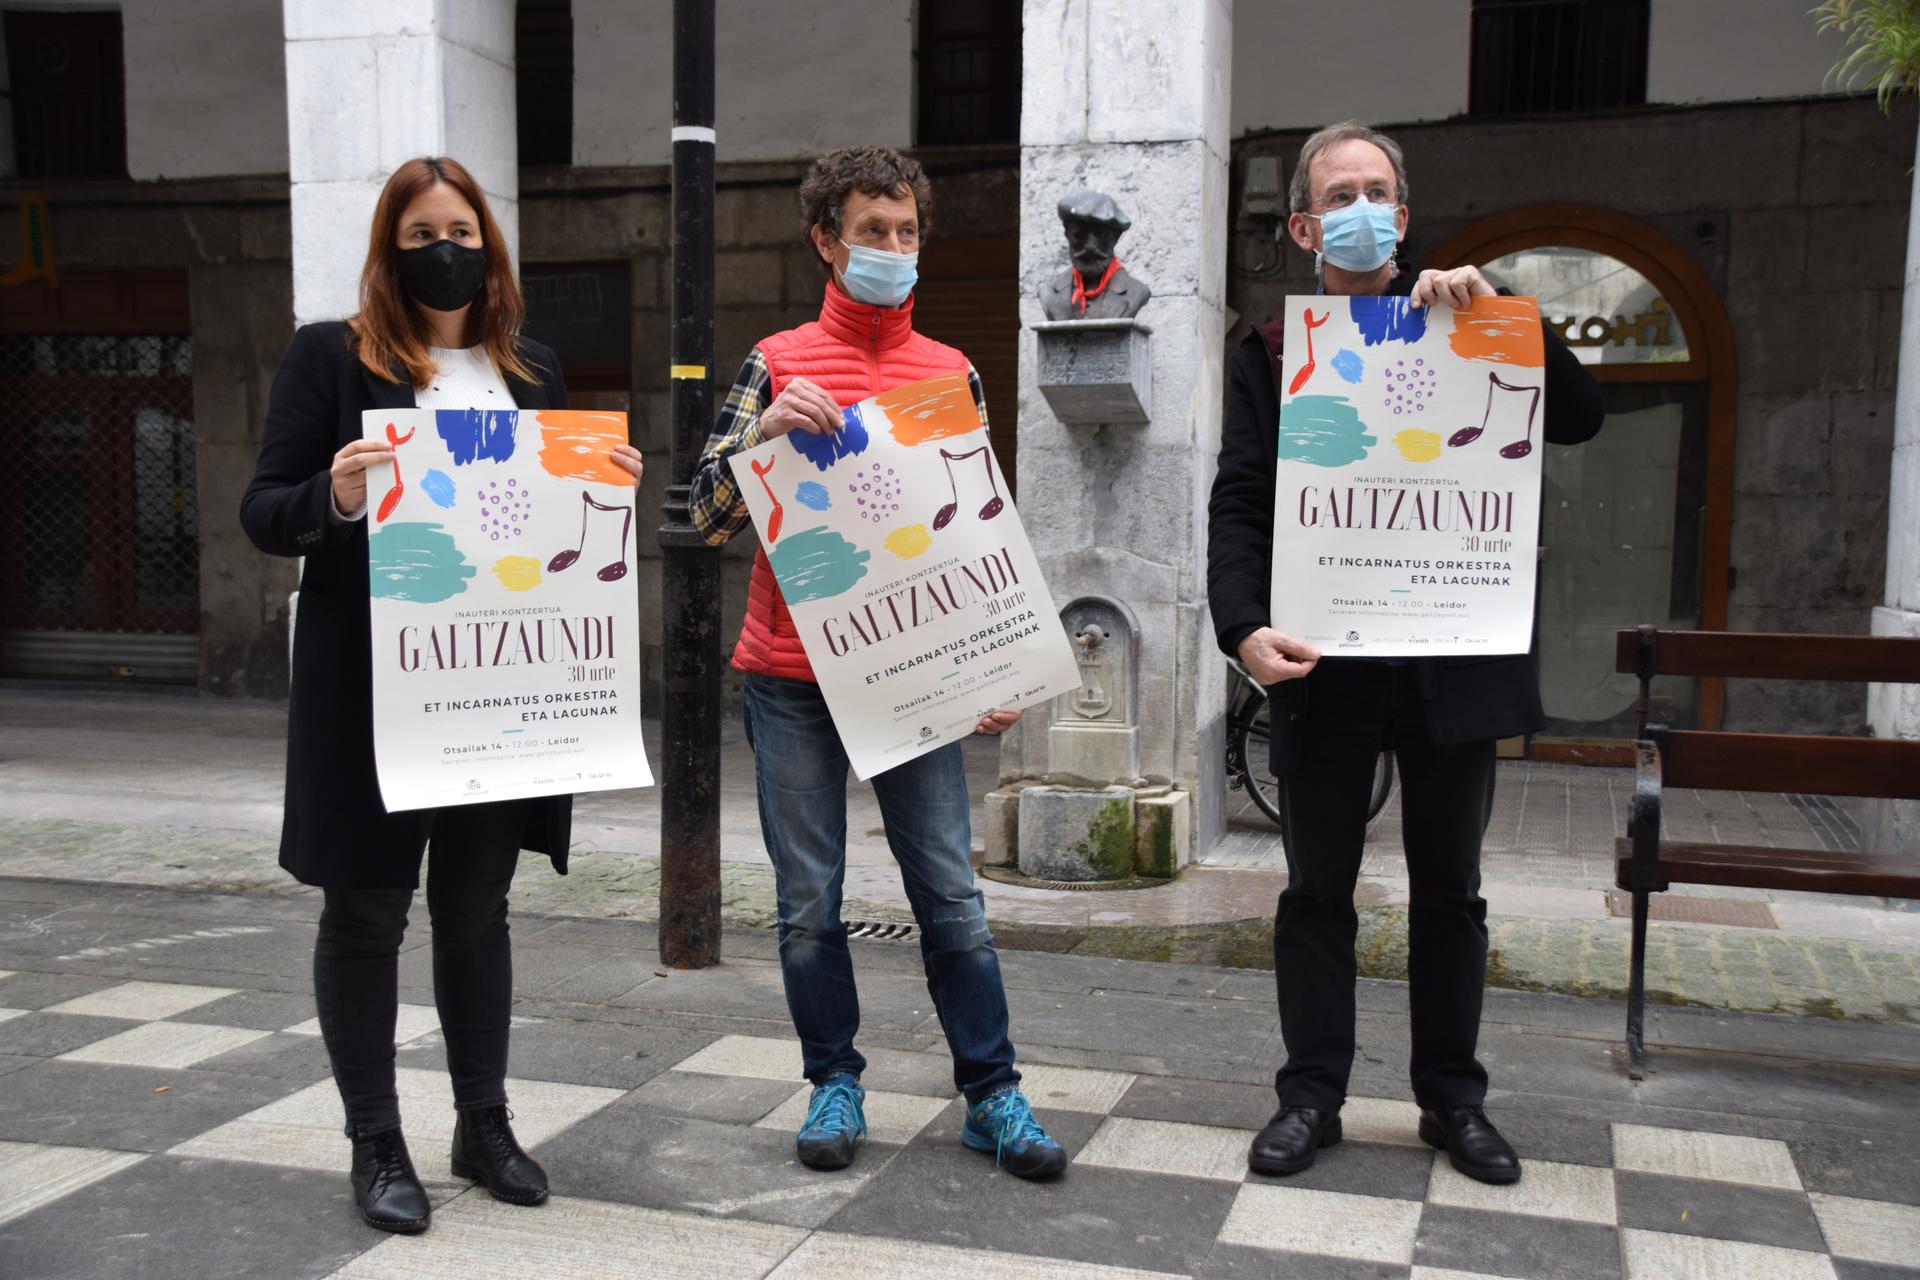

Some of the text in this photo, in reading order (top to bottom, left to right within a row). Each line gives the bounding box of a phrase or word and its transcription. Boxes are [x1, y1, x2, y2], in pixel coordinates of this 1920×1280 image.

[1354, 476, 1460, 486] INAUTERI KONTZERTUA
[1299, 485, 1515, 533] GALTZAUNDI
[1461, 535, 1512, 553] 30 urte
[1318, 556, 1512, 571] ET INCARNATUS ORKESTRA
[864, 557, 960, 598] INAUTERI KONTZERTUA
[1411, 575, 1511, 586] ETA LAGUNAK
[455, 606, 562, 619] INAUTERI KONTZERTUA
[822, 547, 1021, 658] GALTZAUNDI
[982, 589, 1028, 619] 30 urte
[1332, 598, 1374, 607] Otsailak
[1433, 600, 1466, 608] Leidor
[399, 615, 616, 673] GALTZAUNDI
[865, 610, 1036, 685] ET INCARNATUS ORKESTRA
[953, 623, 1042, 665] ETA LAGUNAK
[567, 665, 616, 682] 30 urte
[893, 694, 932, 713] Otsailak
[934, 688, 945, 697] 14
[983, 662, 1013, 677] Leidor
[424, 689, 618, 713] ET INCARNATUS ORKESTRA
[521, 705, 618, 722] ETA LAGUNAK
[443, 742, 488, 755] Otsailak
[491, 743, 502, 751] 14
[548, 736, 580, 745] Leidor
